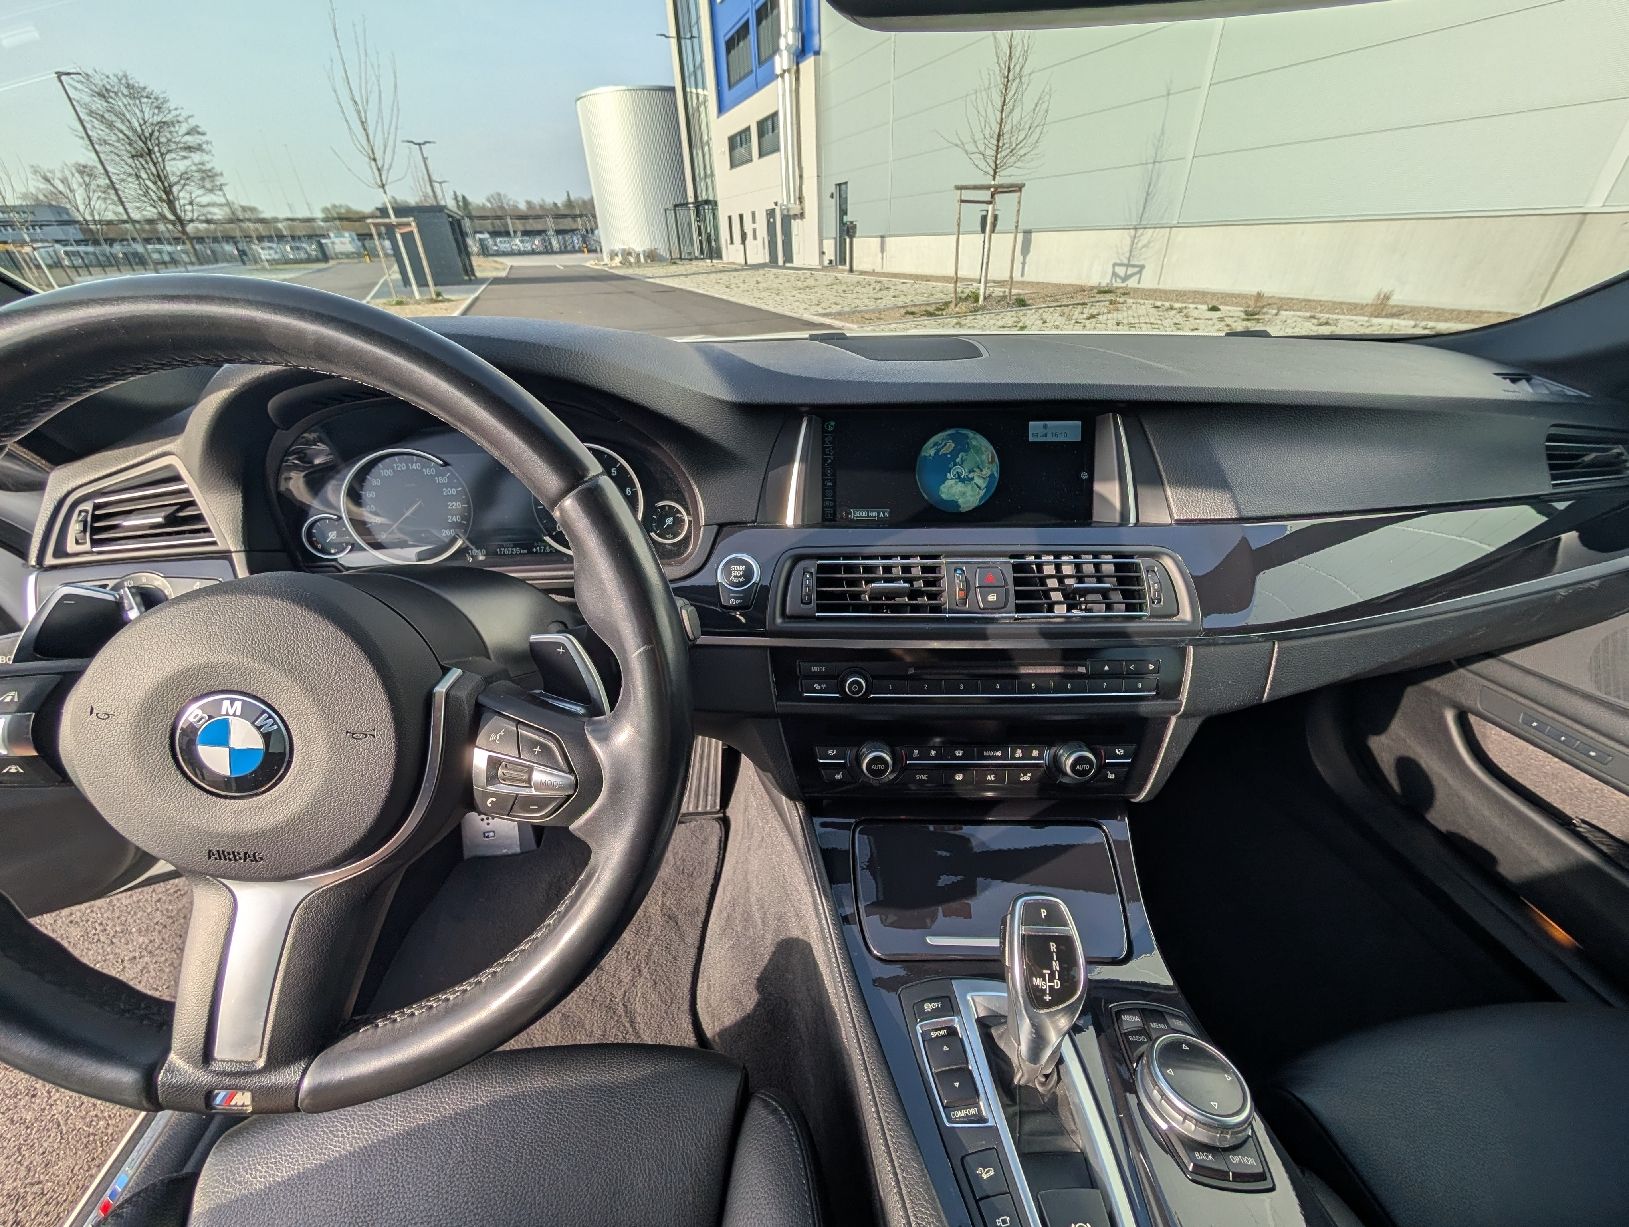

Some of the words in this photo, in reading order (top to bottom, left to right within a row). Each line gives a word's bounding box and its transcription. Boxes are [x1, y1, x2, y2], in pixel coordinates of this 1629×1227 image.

[380, 469, 393, 477] 100
[422, 467, 436, 475] 160
[611, 468, 617, 476] 5
[434, 476, 448, 484] 180
[625, 487, 632, 496] 6
[447, 515, 461, 523] 240
[441, 529, 455, 537] 260
[187, 699, 278, 734] BMW
[207, 849, 264, 863] AIRBAG
[1040, 908, 1048, 919] P
[1049, 941, 1057, 952] R
[1052, 960, 1060, 971] N
[1054, 979, 1061, 989] D
[931, 1001, 942, 1010] OFF
[1121, 1014, 1141, 1022] MEDIA
[1149, 1022, 1168, 1030] MENU
[930, 1029, 948, 1038] SPORT
[950, 1107, 979, 1119] COMFORT
[1194, 1151, 1215, 1161] BACK
[1229, 1155, 1257, 1166] OPTION
